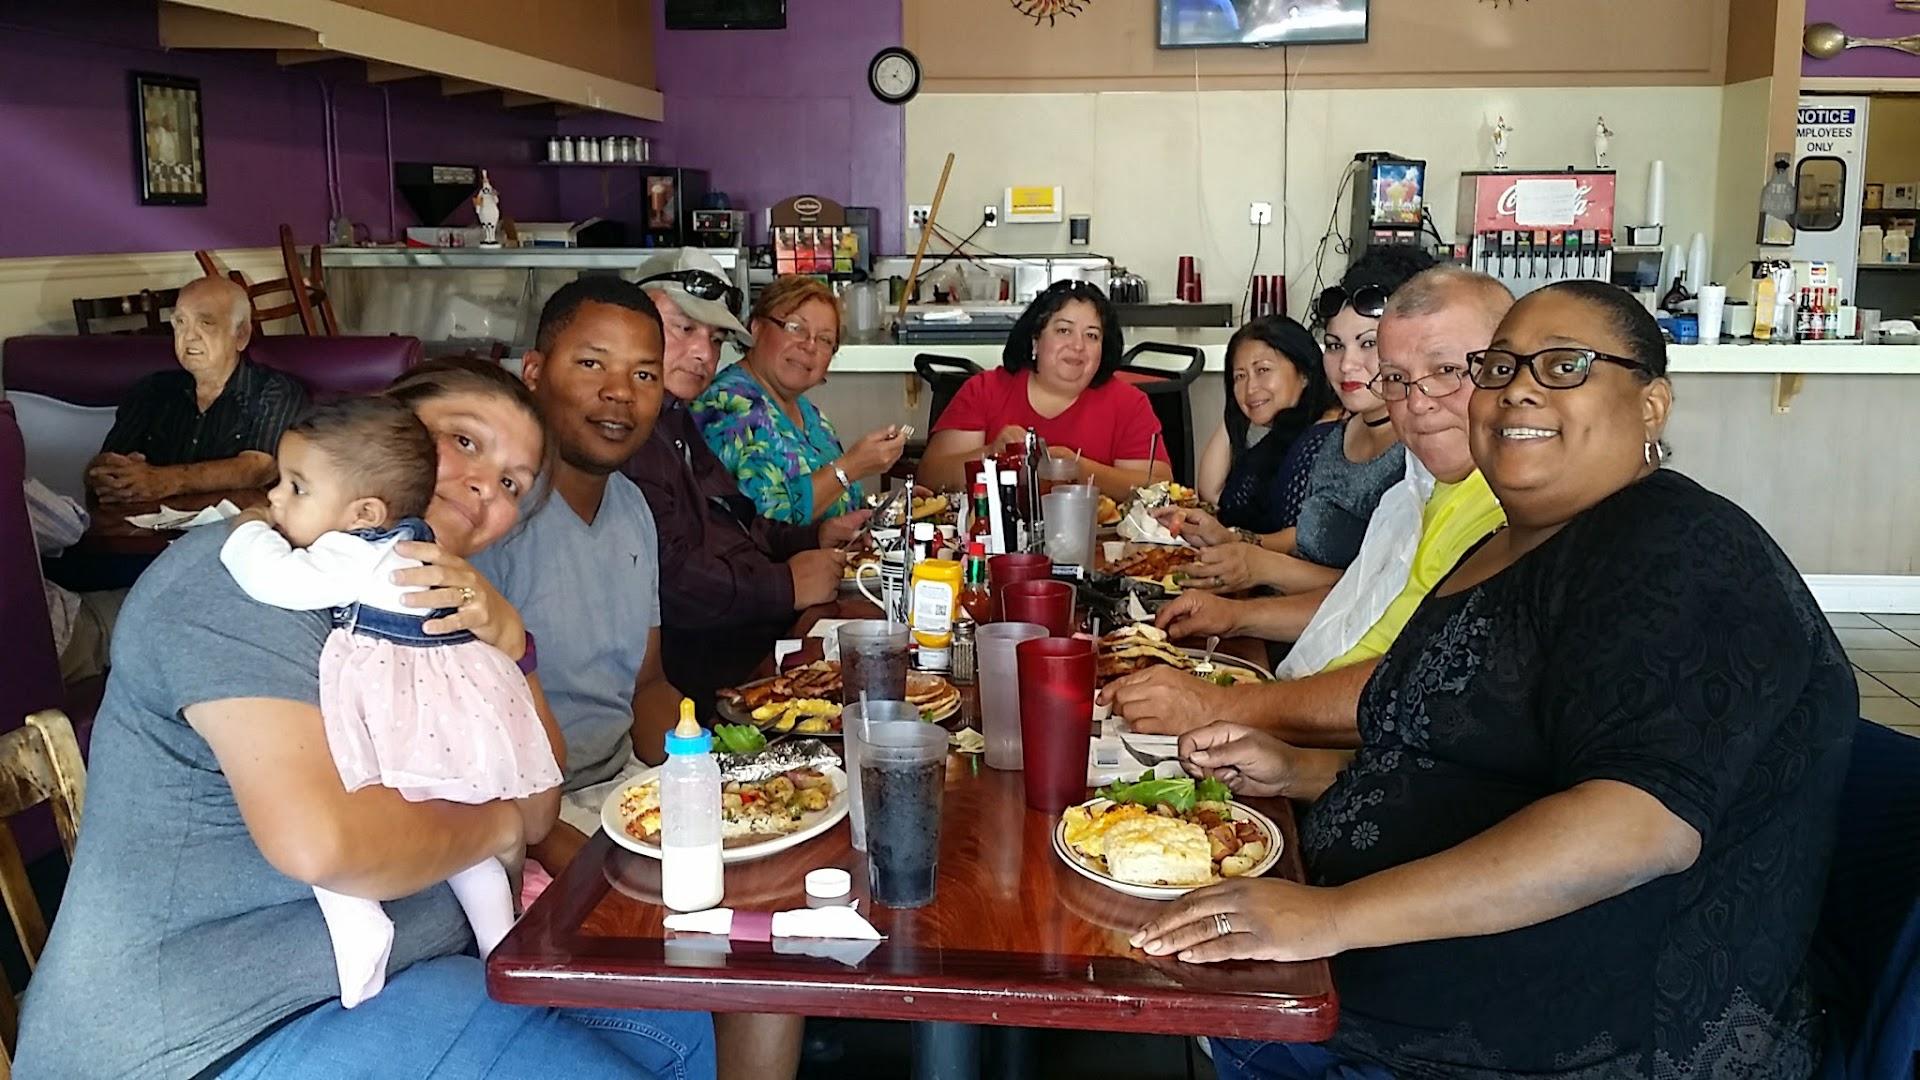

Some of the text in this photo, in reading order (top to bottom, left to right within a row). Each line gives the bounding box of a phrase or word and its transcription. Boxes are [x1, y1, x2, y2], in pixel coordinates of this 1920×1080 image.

[1797, 110, 1850, 123] NOTICE
[1796, 128, 1853, 138] MPLOYEES
[1807, 142, 1834, 152] ONLY
